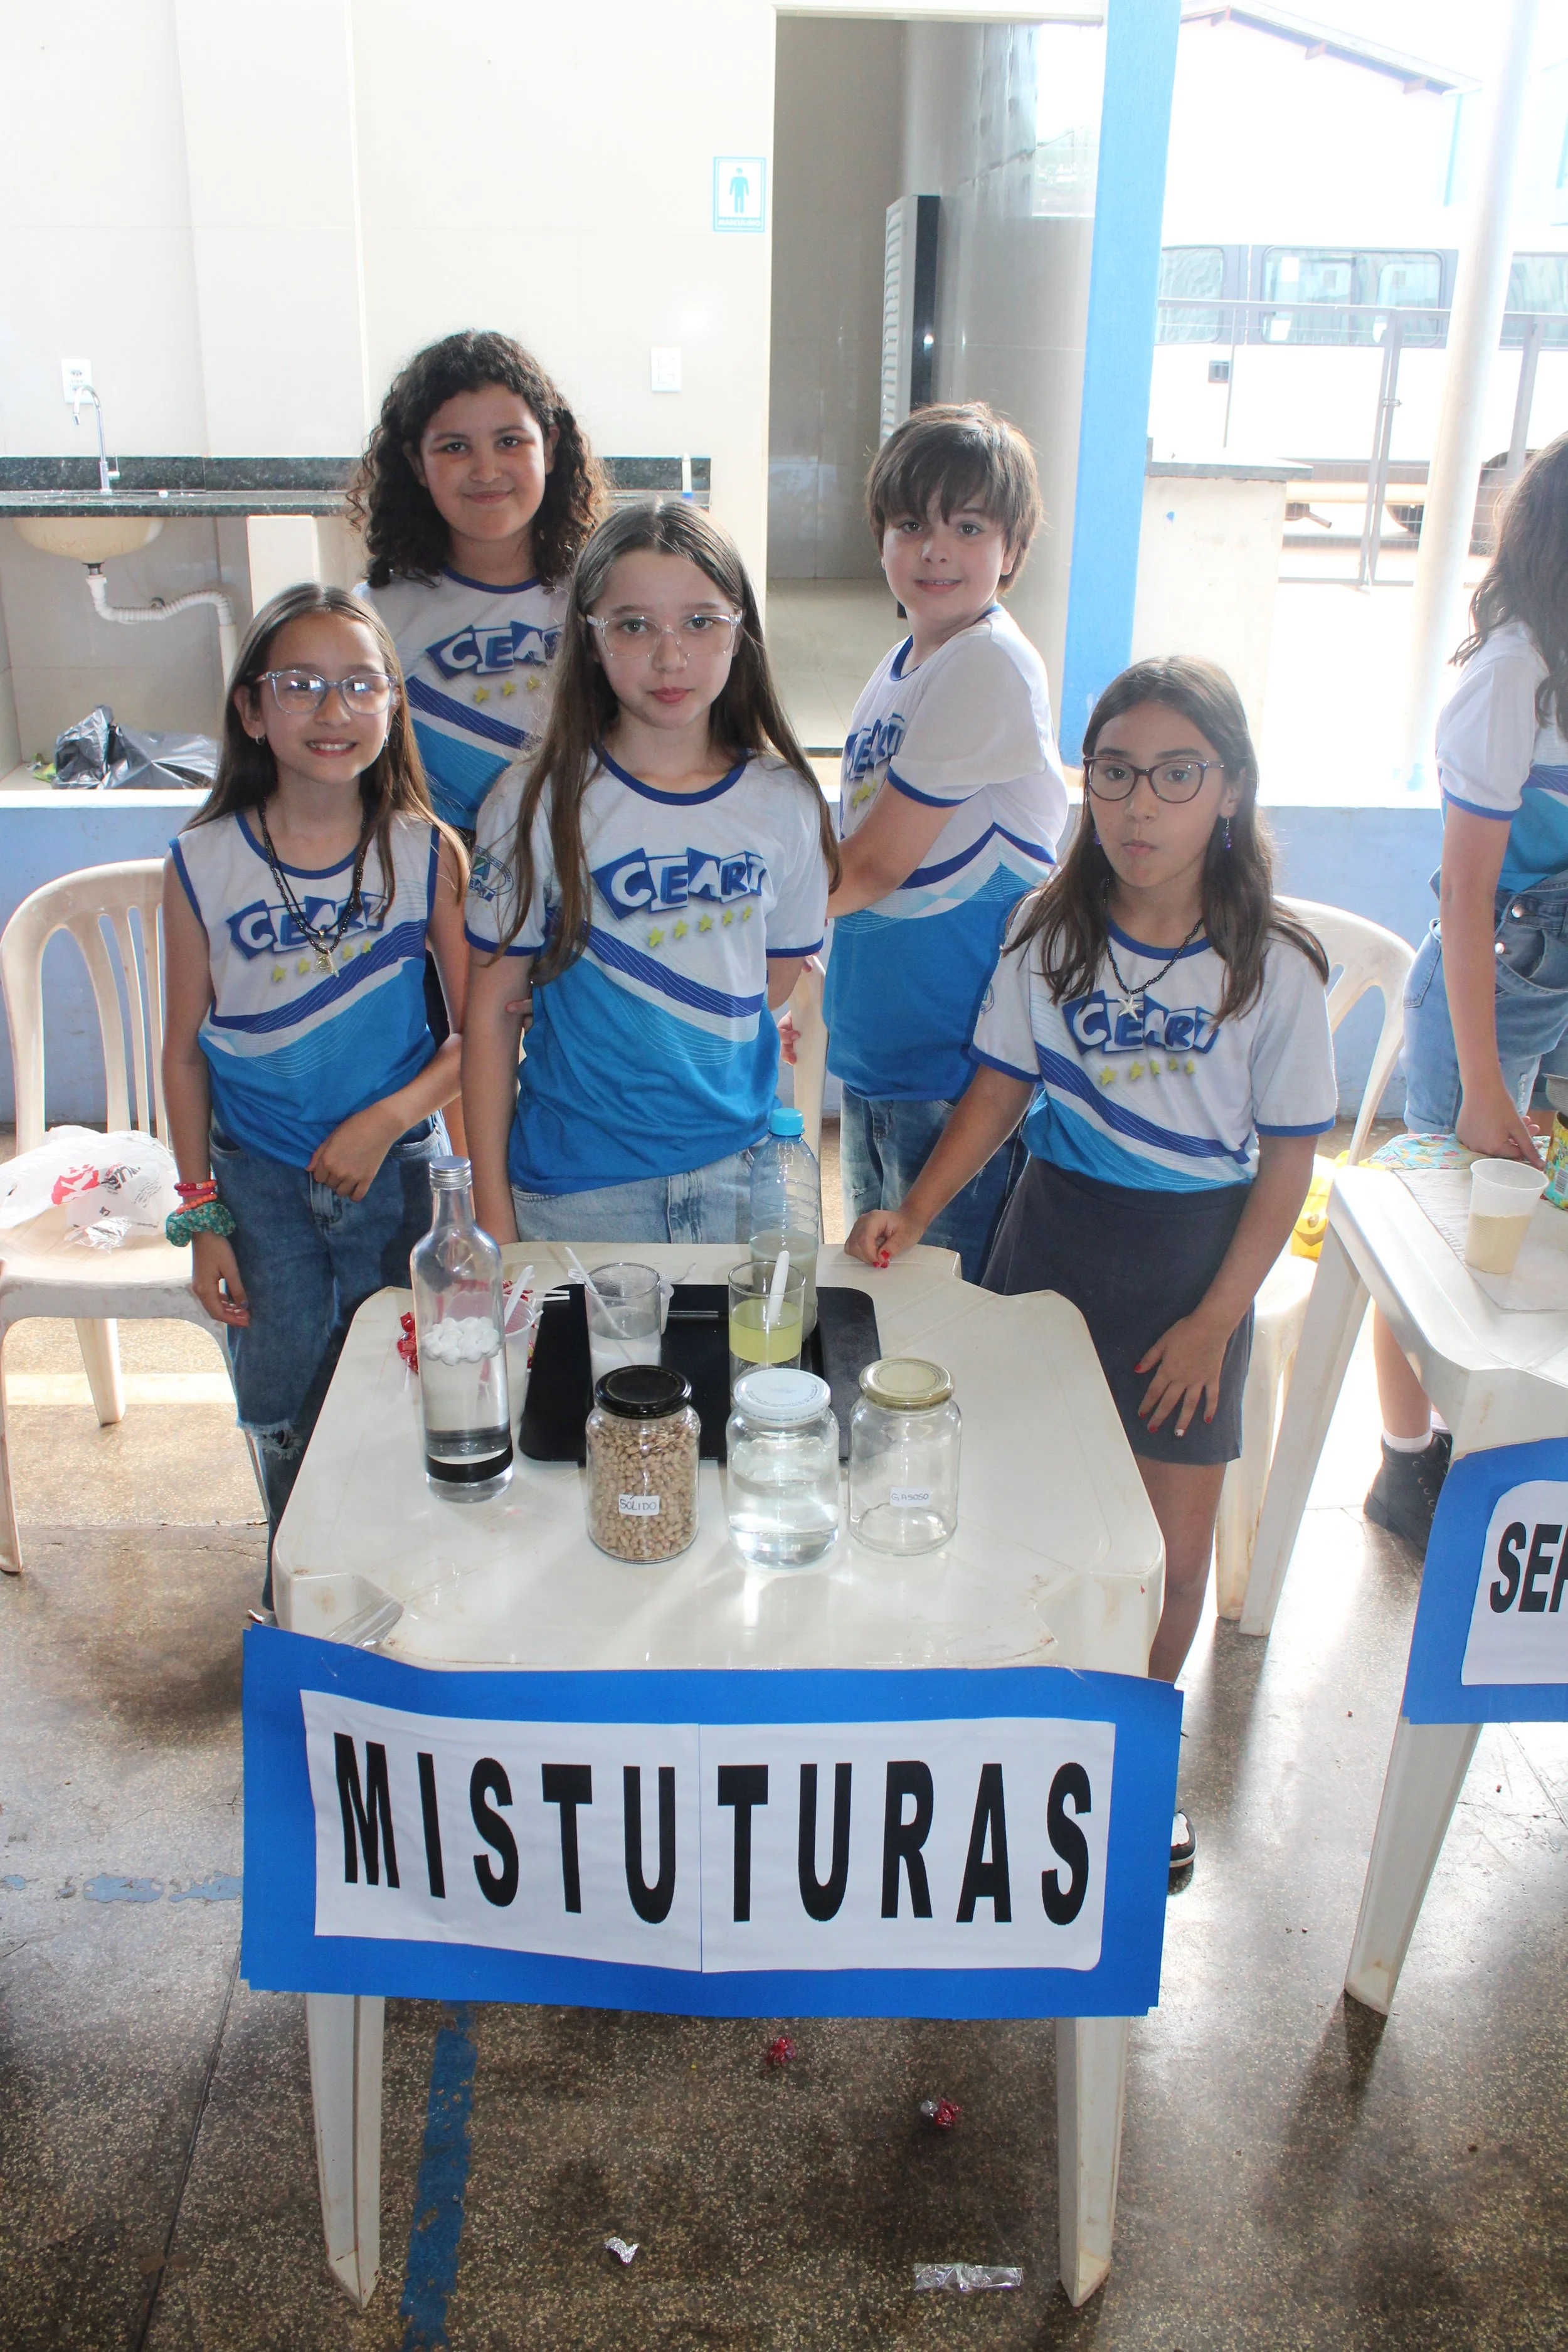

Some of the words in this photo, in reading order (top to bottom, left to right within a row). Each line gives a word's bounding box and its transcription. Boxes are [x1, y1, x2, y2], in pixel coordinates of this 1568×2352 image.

[718, 218, 761, 226] MASCULINO
[610, 854, 766, 908] CEART
[1073, 1002, 1218, 1048] CEART
[620, 1495, 656, 1510] SÓLIDO
[334, 1732, 1091, 1926] MISTUTURAS
